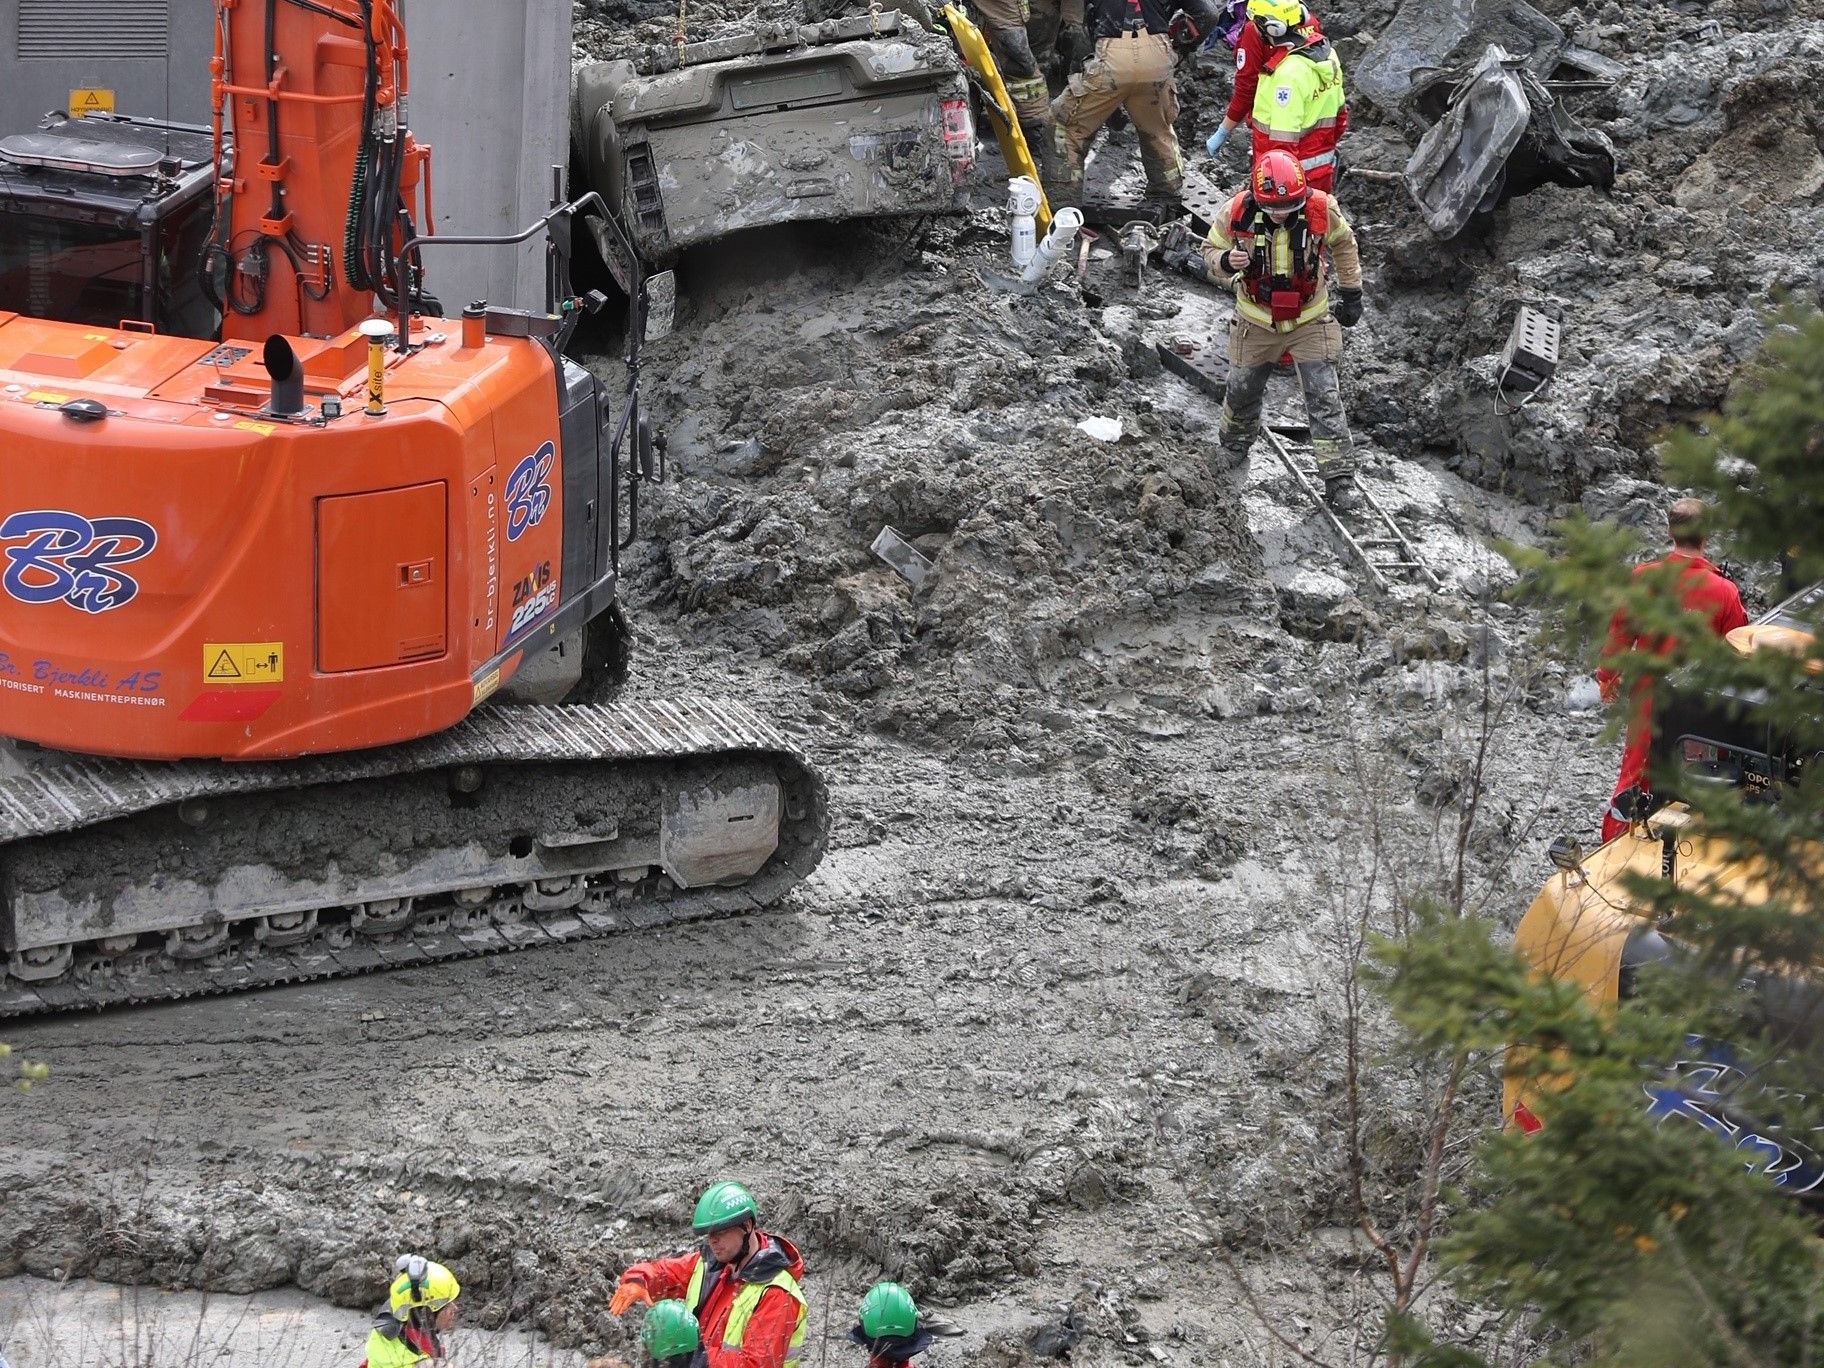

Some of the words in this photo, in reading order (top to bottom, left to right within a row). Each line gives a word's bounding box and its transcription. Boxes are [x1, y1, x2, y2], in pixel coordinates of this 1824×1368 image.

[486, 493, 497, 631] br-bjerkli.no
[512, 560, 551, 607] ZAXIS
[33, 658, 108, 687] Bjerkli
[115, 669, 162, 692] AS
[54, 688, 166, 706] MASKINENTREPRENØR
